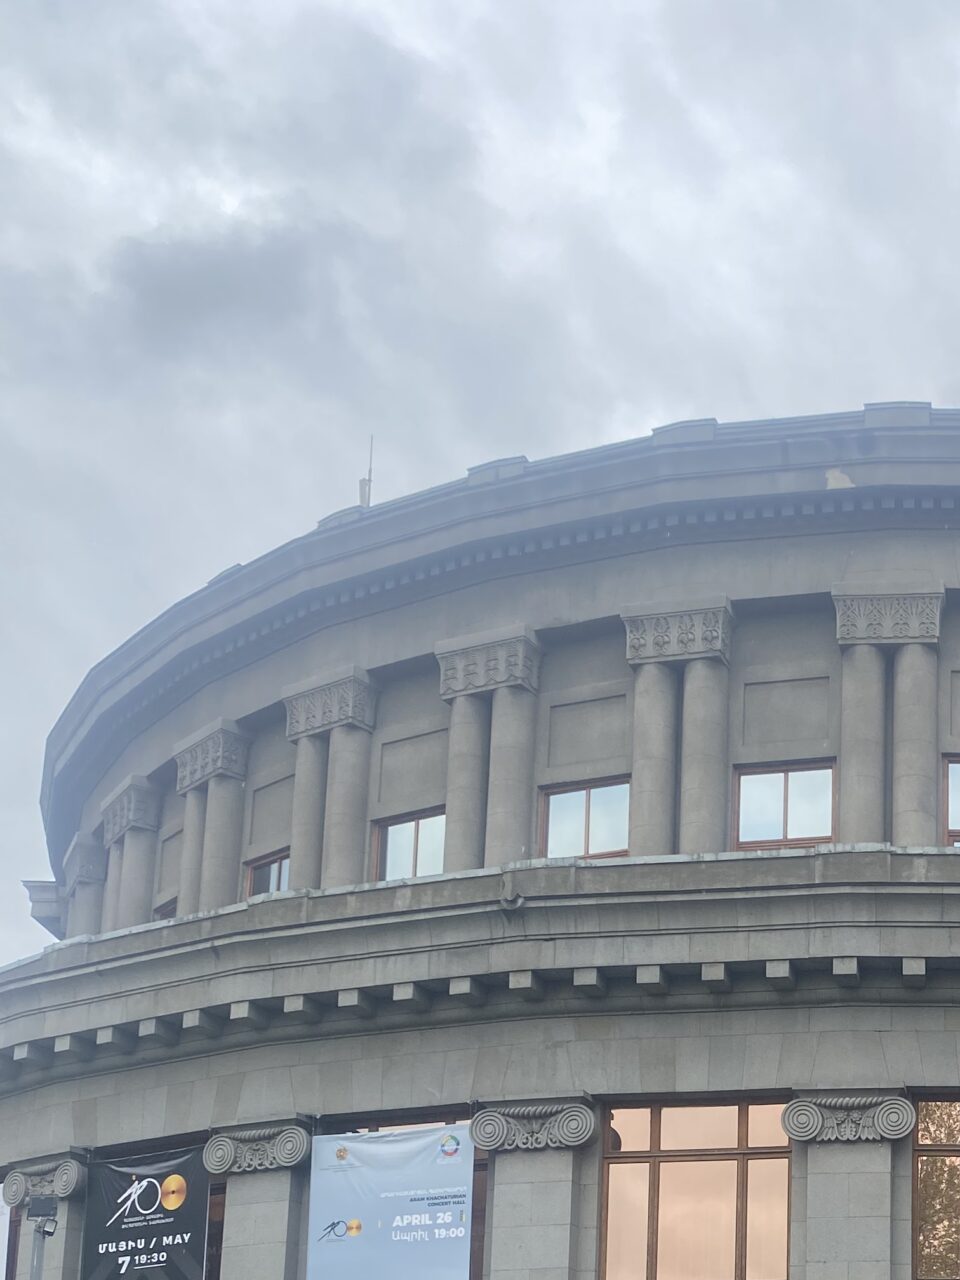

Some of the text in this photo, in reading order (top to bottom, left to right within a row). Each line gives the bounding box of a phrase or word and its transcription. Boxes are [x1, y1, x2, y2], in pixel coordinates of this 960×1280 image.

[392, 1214, 432, 1228] APRIL
[436, 1212, 453, 1224] 26
[434, 1227, 465, 1239] 19:00
[98, 1239, 145, 1254] ՄԱՅԻՍ
[162, 1233, 192, 1246] MAY
[117, 1252, 167, 1274] 7 19:30
